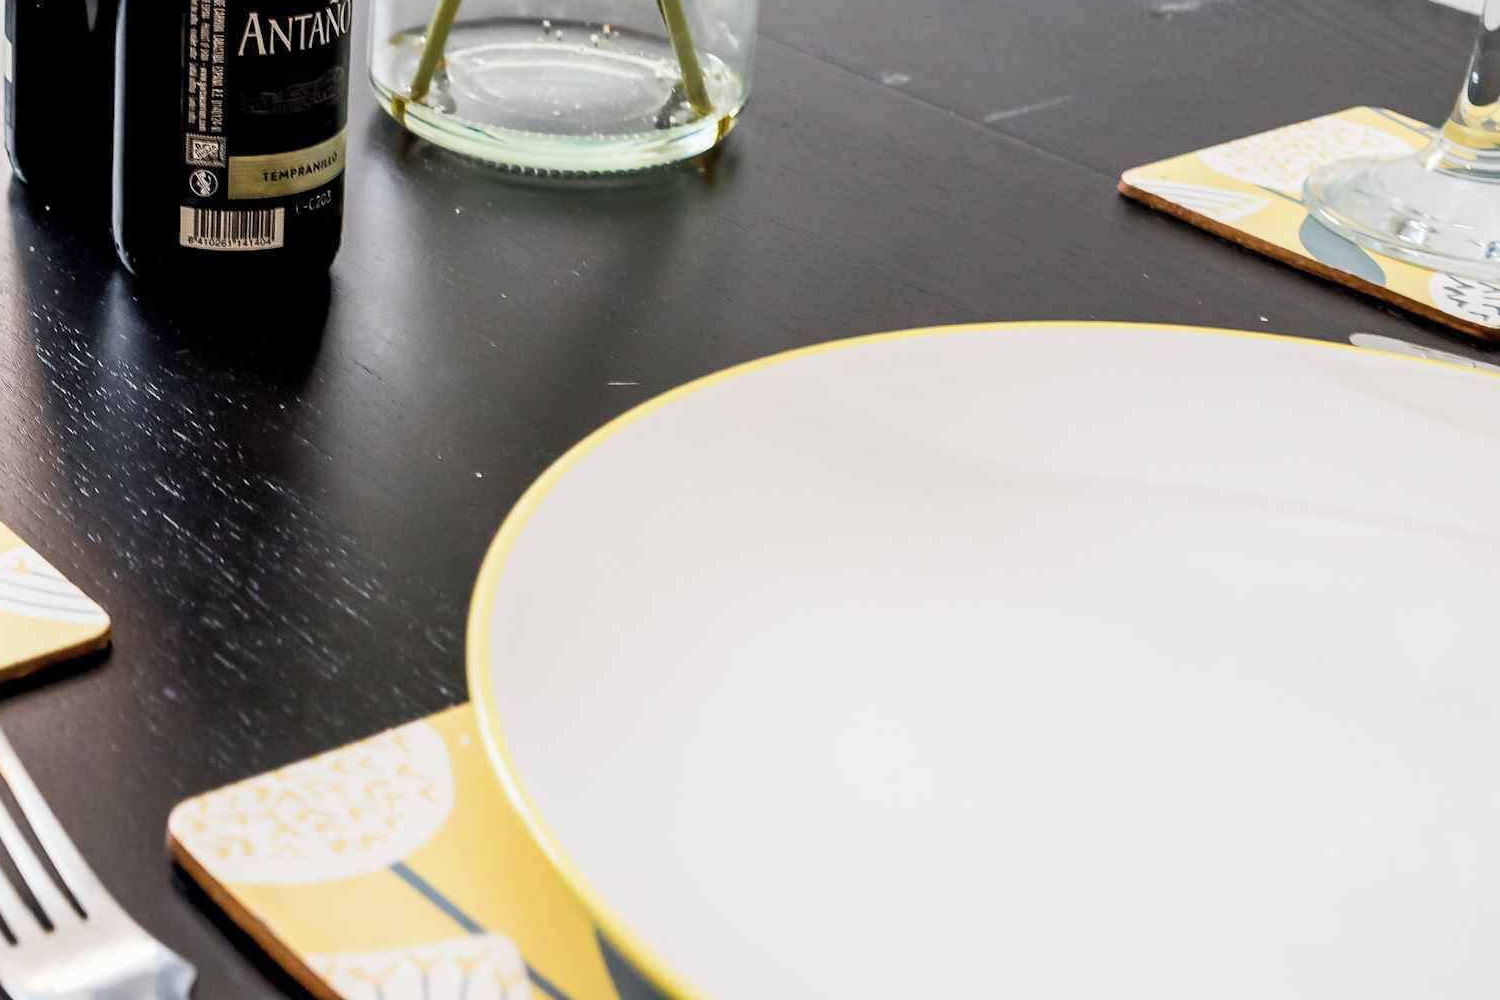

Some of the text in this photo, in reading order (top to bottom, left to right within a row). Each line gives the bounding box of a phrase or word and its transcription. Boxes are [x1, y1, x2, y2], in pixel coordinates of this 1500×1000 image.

[262, 152, 338, 182] TEMPRANILLO
[198, 237, 231, 248] 410261
[237, 237, 272, 248] 141404
